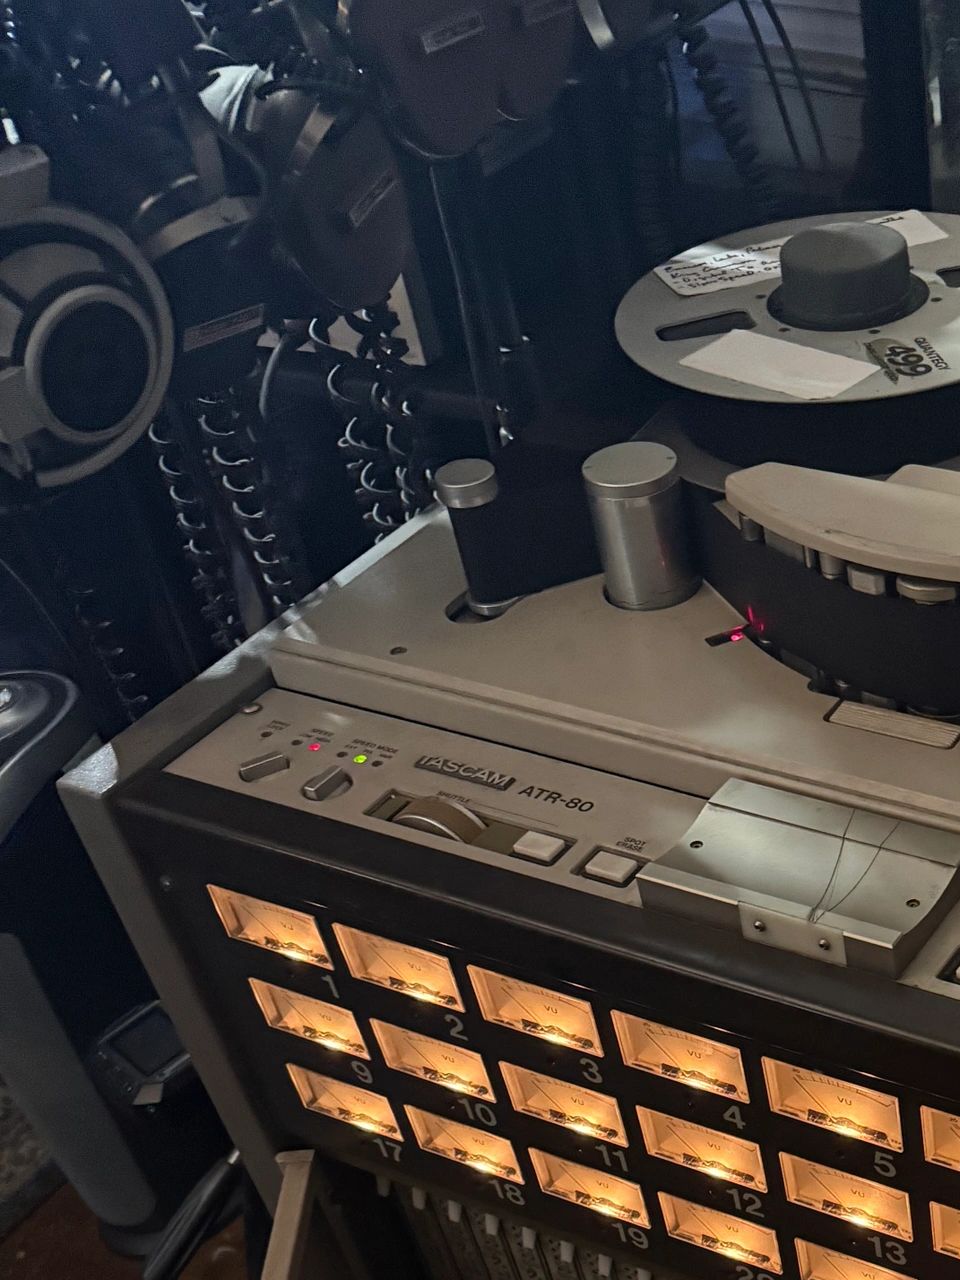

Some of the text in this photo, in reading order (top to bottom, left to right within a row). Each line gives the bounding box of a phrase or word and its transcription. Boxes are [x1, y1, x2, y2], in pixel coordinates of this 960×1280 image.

[884, 345, 932, 376] 499
[914, 337, 952, 370] QUANTEGY
[420, 755, 511, 790] TASCAM
[519, 785, 594, 812] ATR-80
[624, 837, 646, 847] SPOT
[321, 974, 340, 999] 1
[544, 1004, 558, 1014] VU
[444, 1014, 469, 1041] 2
[686, 1048, 702, 1059] VU
[351, 1060, 373, 1084] 9
[579, 1057, 603, 1084] 3
[457, 1098, 497, 1127] 10
[570, 1096, 585, 1106] VU
[836, 1095, 852, 1106] VU
[723, 1105, 747, 1130] 4
[372, 1137, 402, 1162] 17
[595, 1143, 629, 1172] 11
[707, 1141, 721, 1151] VU
[873, 1151, 897, 1178] 5
[489, 1178, 526, 1207] 18
[726, 1187, 765, 1219] 12
[850, 1188, 865, 1198] VU
[611, 1221, 649, 1250] 19
[867, 1236, 907, 1266] 13
